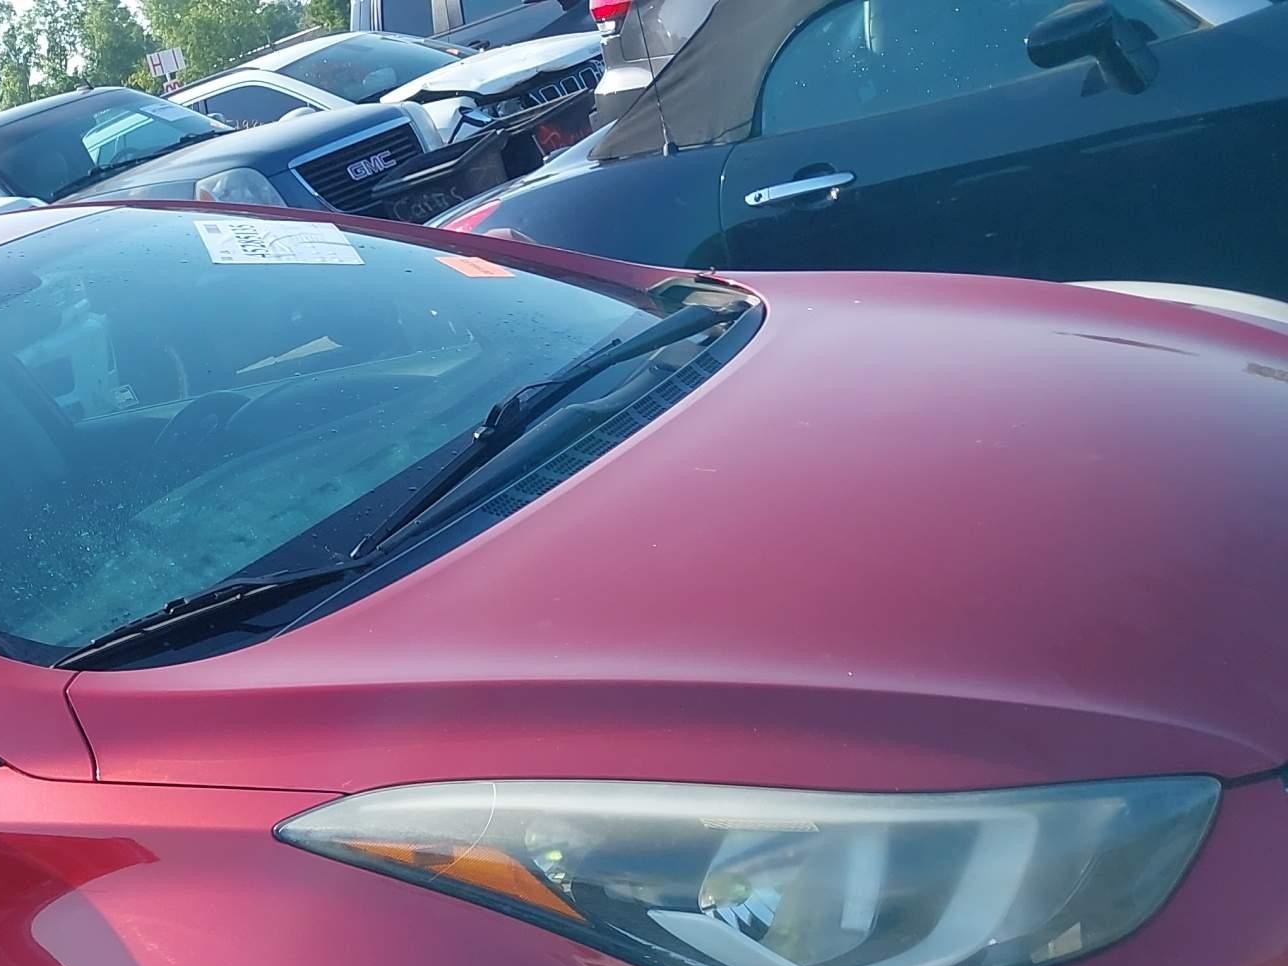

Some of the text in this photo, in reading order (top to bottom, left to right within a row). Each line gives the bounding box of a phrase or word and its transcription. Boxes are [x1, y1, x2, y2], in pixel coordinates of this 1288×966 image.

[149, 54, 165, 75] H
[346, 150, 397, 181] GMC
[228, 224, 269, 258] 45285135
